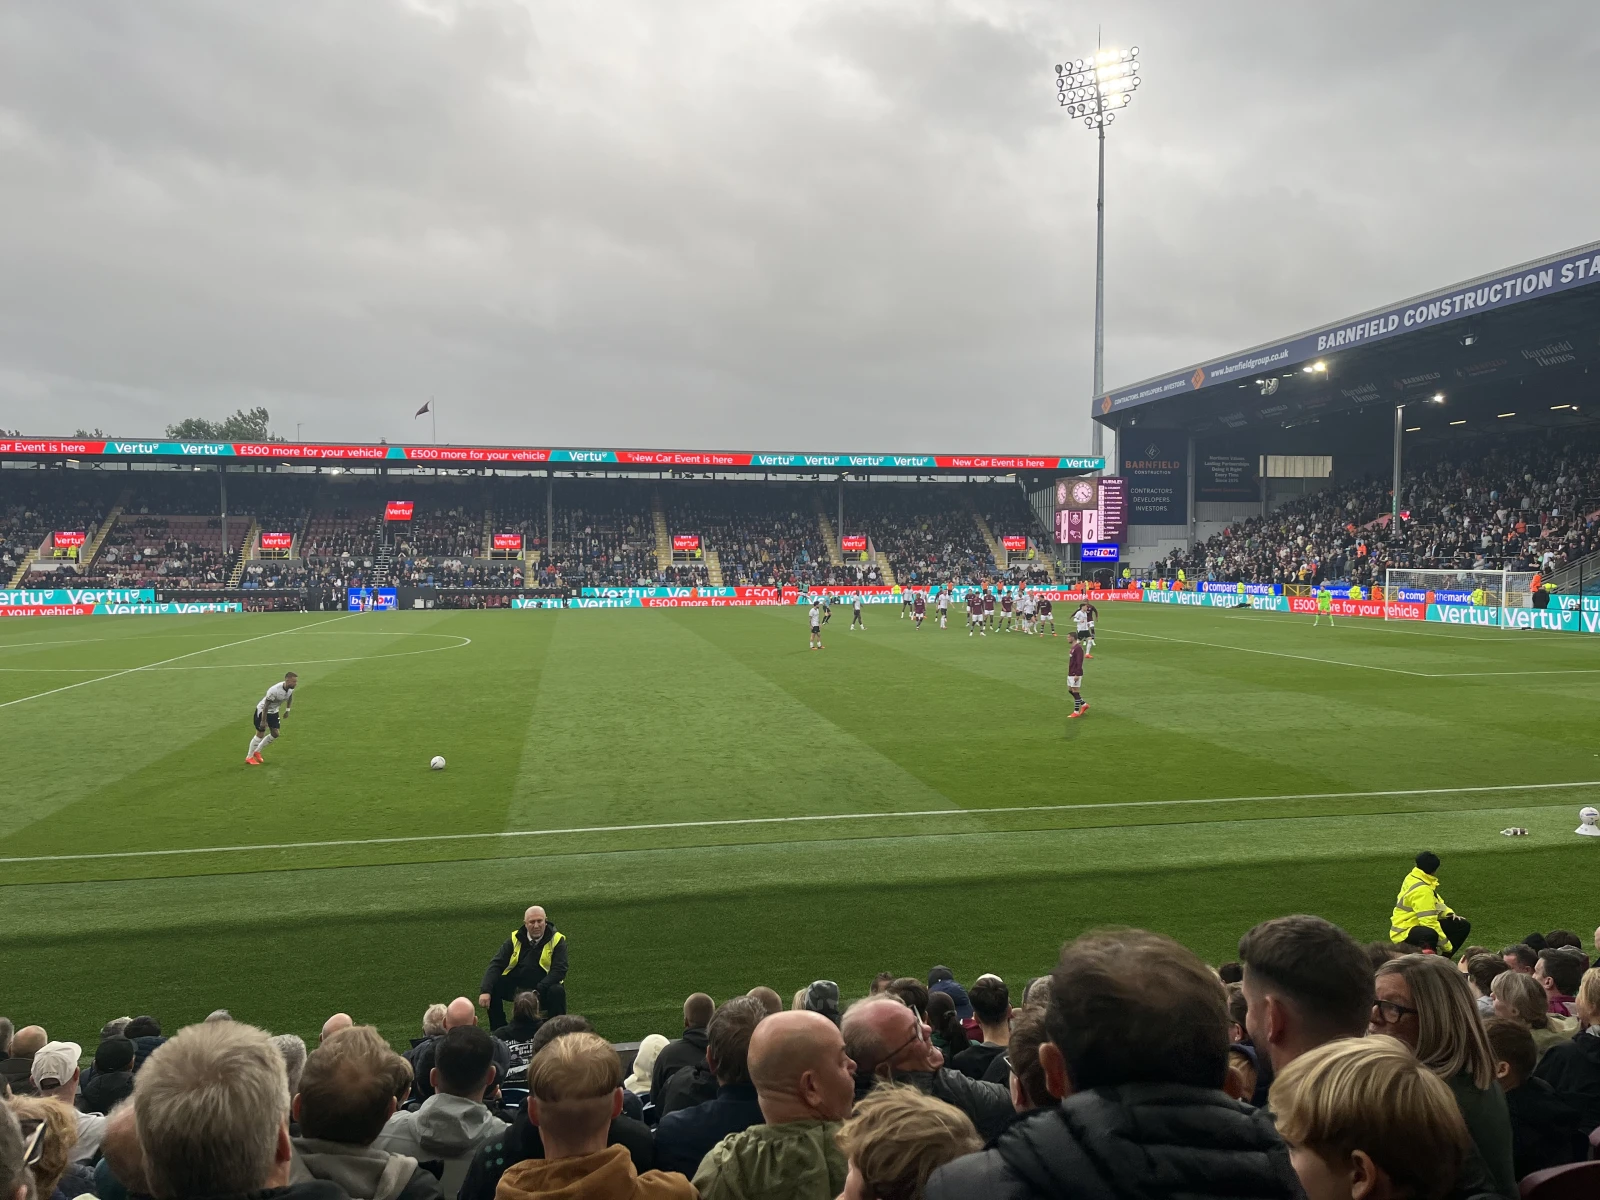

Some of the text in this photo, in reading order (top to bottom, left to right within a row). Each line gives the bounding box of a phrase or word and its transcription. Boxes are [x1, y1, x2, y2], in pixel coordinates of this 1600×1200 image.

[1317, 254, 1600, 351] BARNFIELD CONSTRUCTION STA
[1521, 340, 1573, 360] Barnfield
[1210, 349, 1289, 378] www.barnfieldgroup.co.uk
[1535, 352, 1576, 366] Homes
[1402, 372, 1441, 385] BARNFIELD
[15, 443, 47, 452] Event
[49, 443, 57, 452] is
[61, 443, 86, 452] here
[115, 443, 153, 454] Vertu
[181, 444, 219, 455] Vertu
[240, 446, 383, 458] £500 more for your vehicle
[411, 449, 545, 461] £500 more for your vehicle
[569, 451, 602, 461] Vertu
[632, 454, 733, 464] New Car Event is here
[759, 455, 790, 465] Vertu
[804, 456, 835, 466] Vertu
[849, 456, 880, 466] Vertu
[894, 457, 924, 466] Vertu
[953, 458, 1045, 467] New Car Event is here
[1066, 459, 1094, 468] Vertu
[1125, 460, 1180, 469] BARNFIELD
[1087, 513, 1093, 523] 1
[1087, 529, 1093, 540] 0
[1084, 548, 1116, 556] betTOM
[67, 589, 131, 605] Vertu
[595, 588, 647, 598] Vertu
[667, 588, 719, 597] Vetu
[822, 588, 840, 596] for
[1064, 593, 1088, 601] more
[1090, 591, 1106, 600] for
[1107, 592, 1121, 600] your
[1121, 591, 1140, 600] vehicle
[1146, 590, 1170, 603] Vertu
[516, 599, 563, 608] Vetu
[577, 599, 624, 608] Vertu
[649, 599, 678, 607] £500
[711, 599, 726, 607] for
[861, 595, 904, 604] Vertu
[1175, 592, 1202, 605] Vertu
[1209, 593, 1238, 608] Vertu
[1246, 595, 1276, 610] ertu
[40, 606, 84, 616] vehicle
[105, 604, 160, 614] Vertu
[175, 603, 230, 614] Vertu
[1293, 599, 1315, 611] £500
[1342, 600, 1357, 613] for
[1359, 604, 1380, 616] your
[1384, 603, 1419, 618] vehicle
[1437, 605, 1489, 626] Vertu
[1504, 608, 1562, 630] Vertu
[1582, 611, 1600, 632] V
